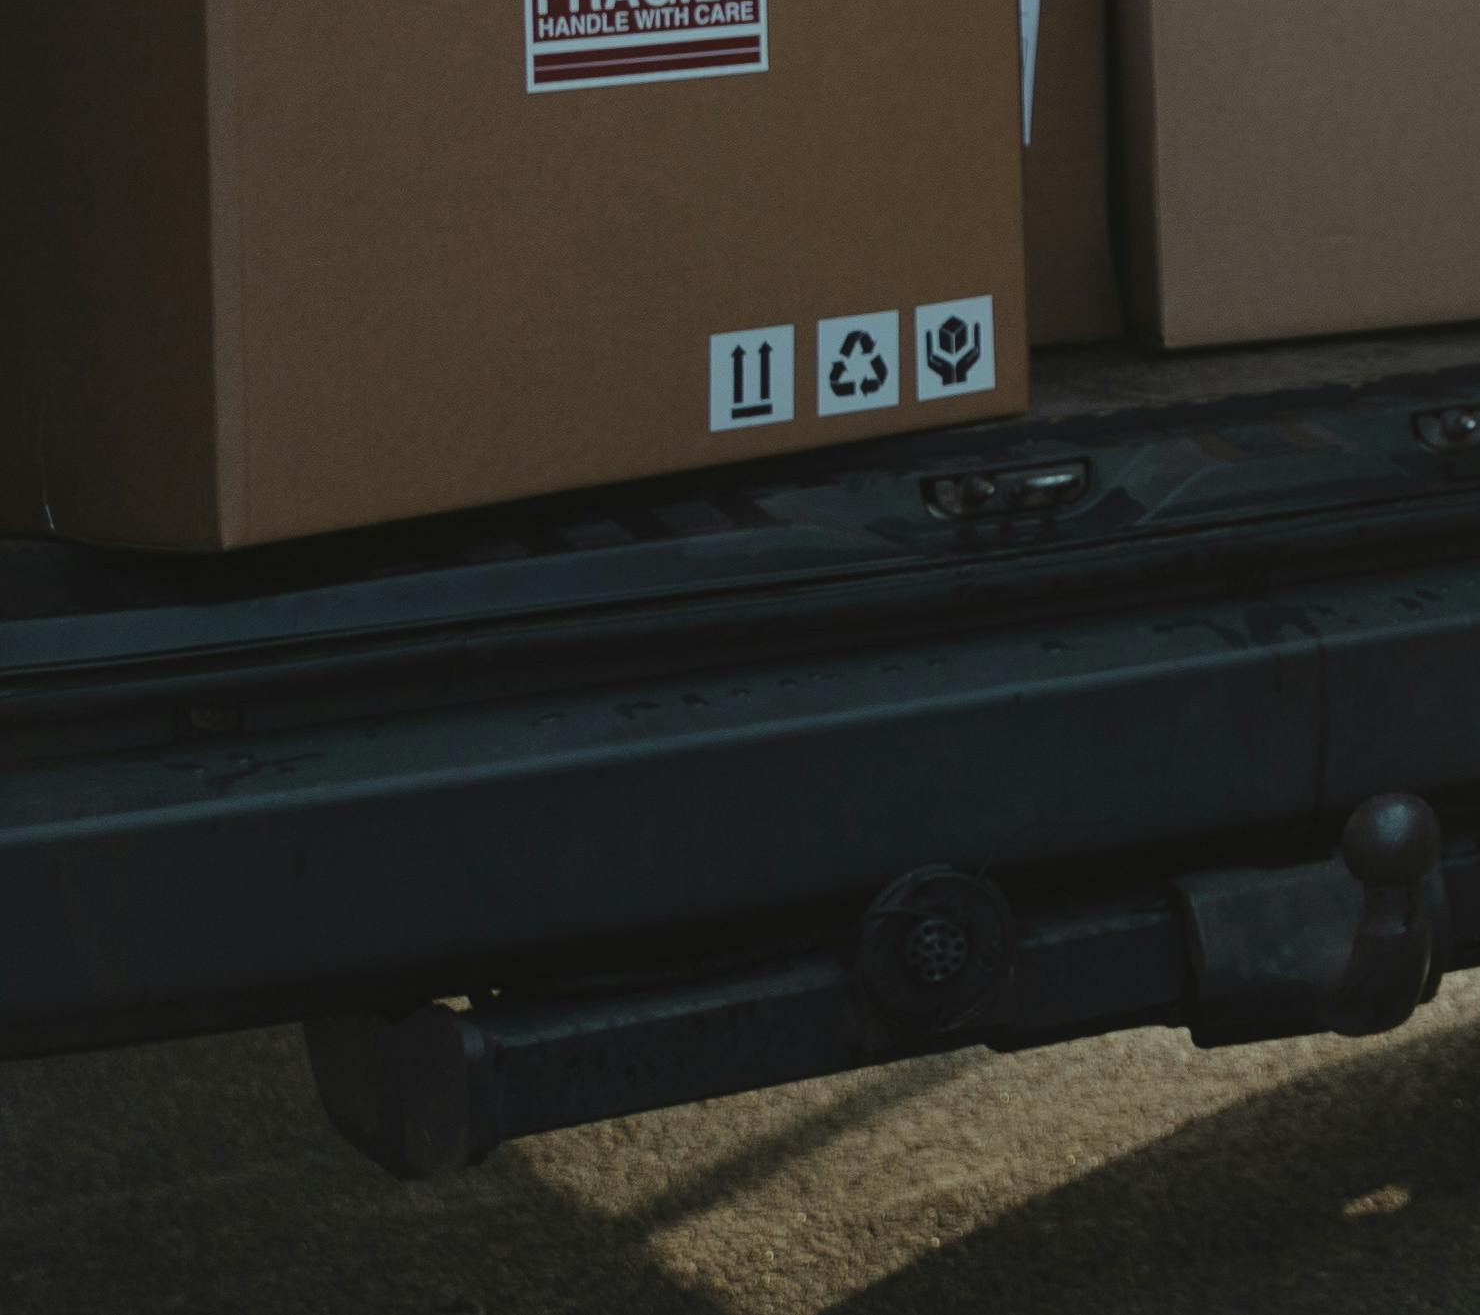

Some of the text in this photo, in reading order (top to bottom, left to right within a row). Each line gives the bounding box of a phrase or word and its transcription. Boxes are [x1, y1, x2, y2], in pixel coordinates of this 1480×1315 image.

[538, 0, 754, 39] HANDLE WITH CARE
